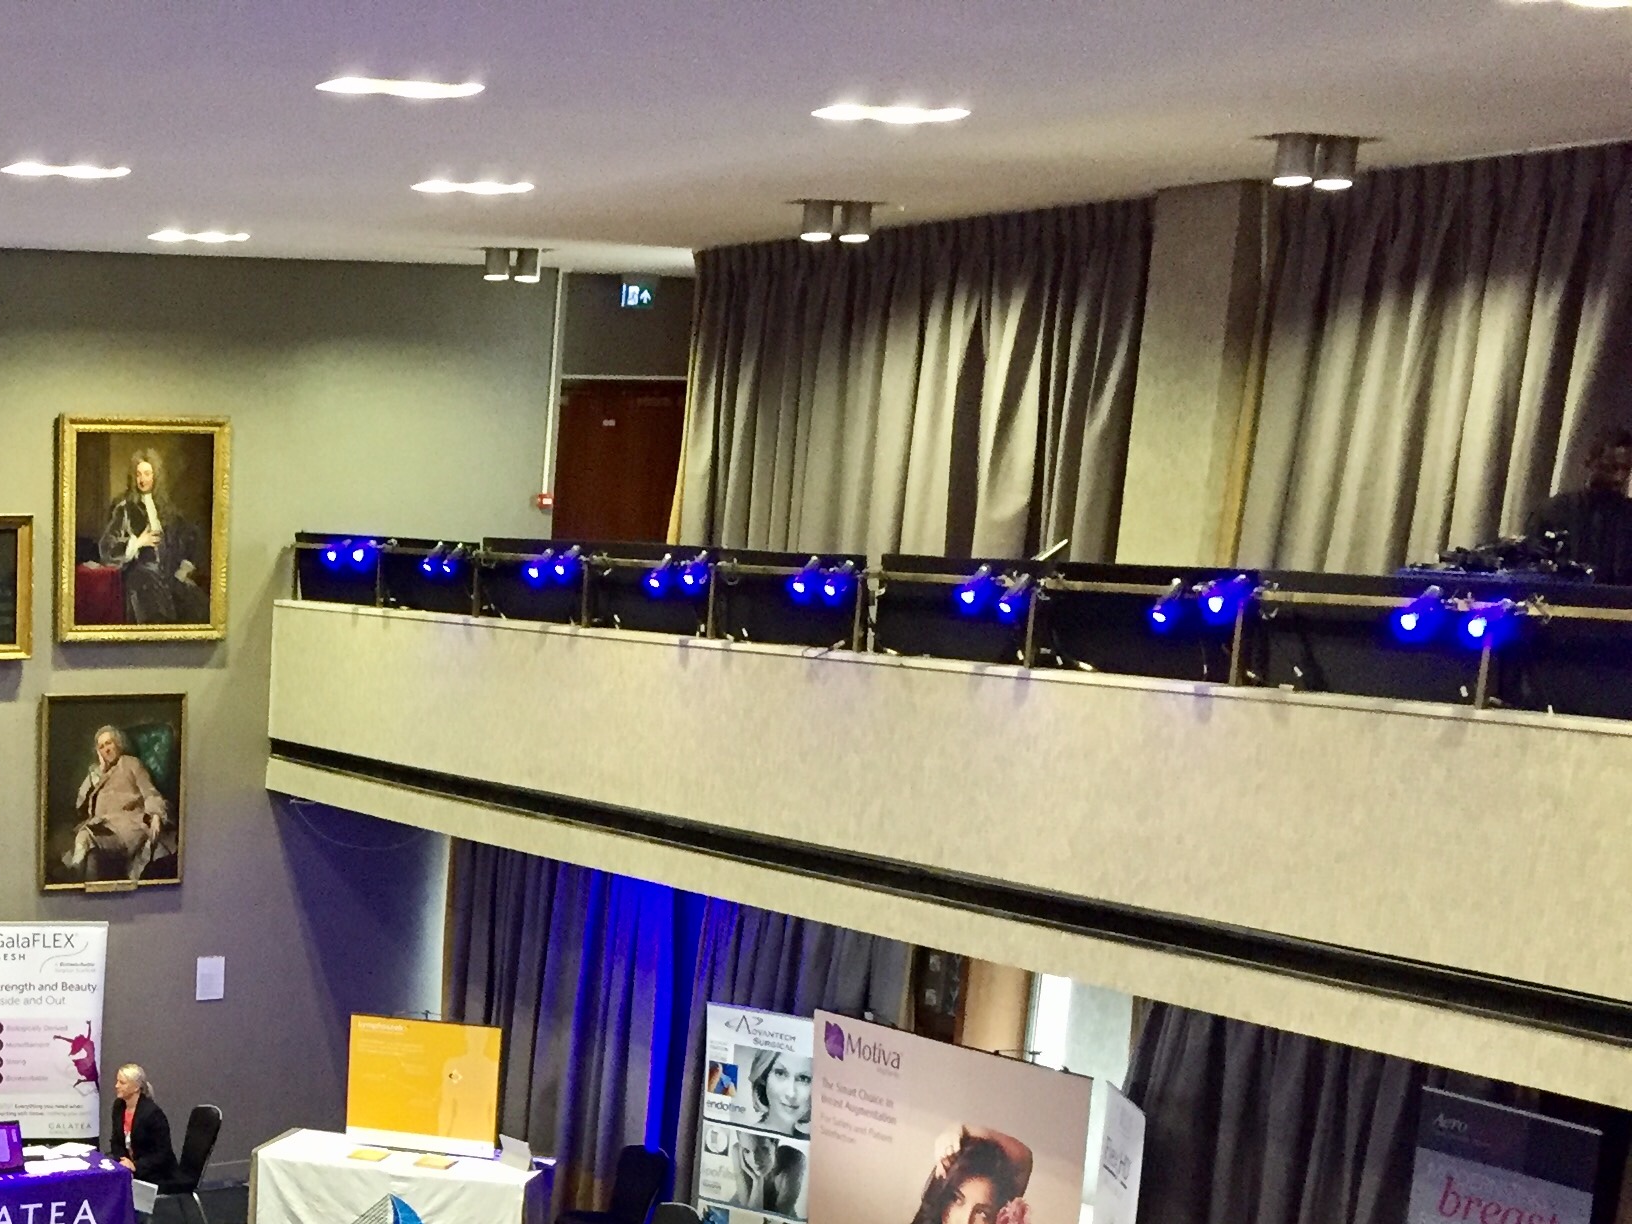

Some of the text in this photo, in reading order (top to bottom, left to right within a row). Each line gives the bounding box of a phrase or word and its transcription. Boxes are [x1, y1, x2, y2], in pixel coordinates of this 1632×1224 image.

[38, 982, 58, 992] and
[61, 982, 97, 994] Beauty
[23, 996, 43, 1006] and
[45, 995, 66, 1006] Out
[847, 1033, 901, 1070] Motiva
